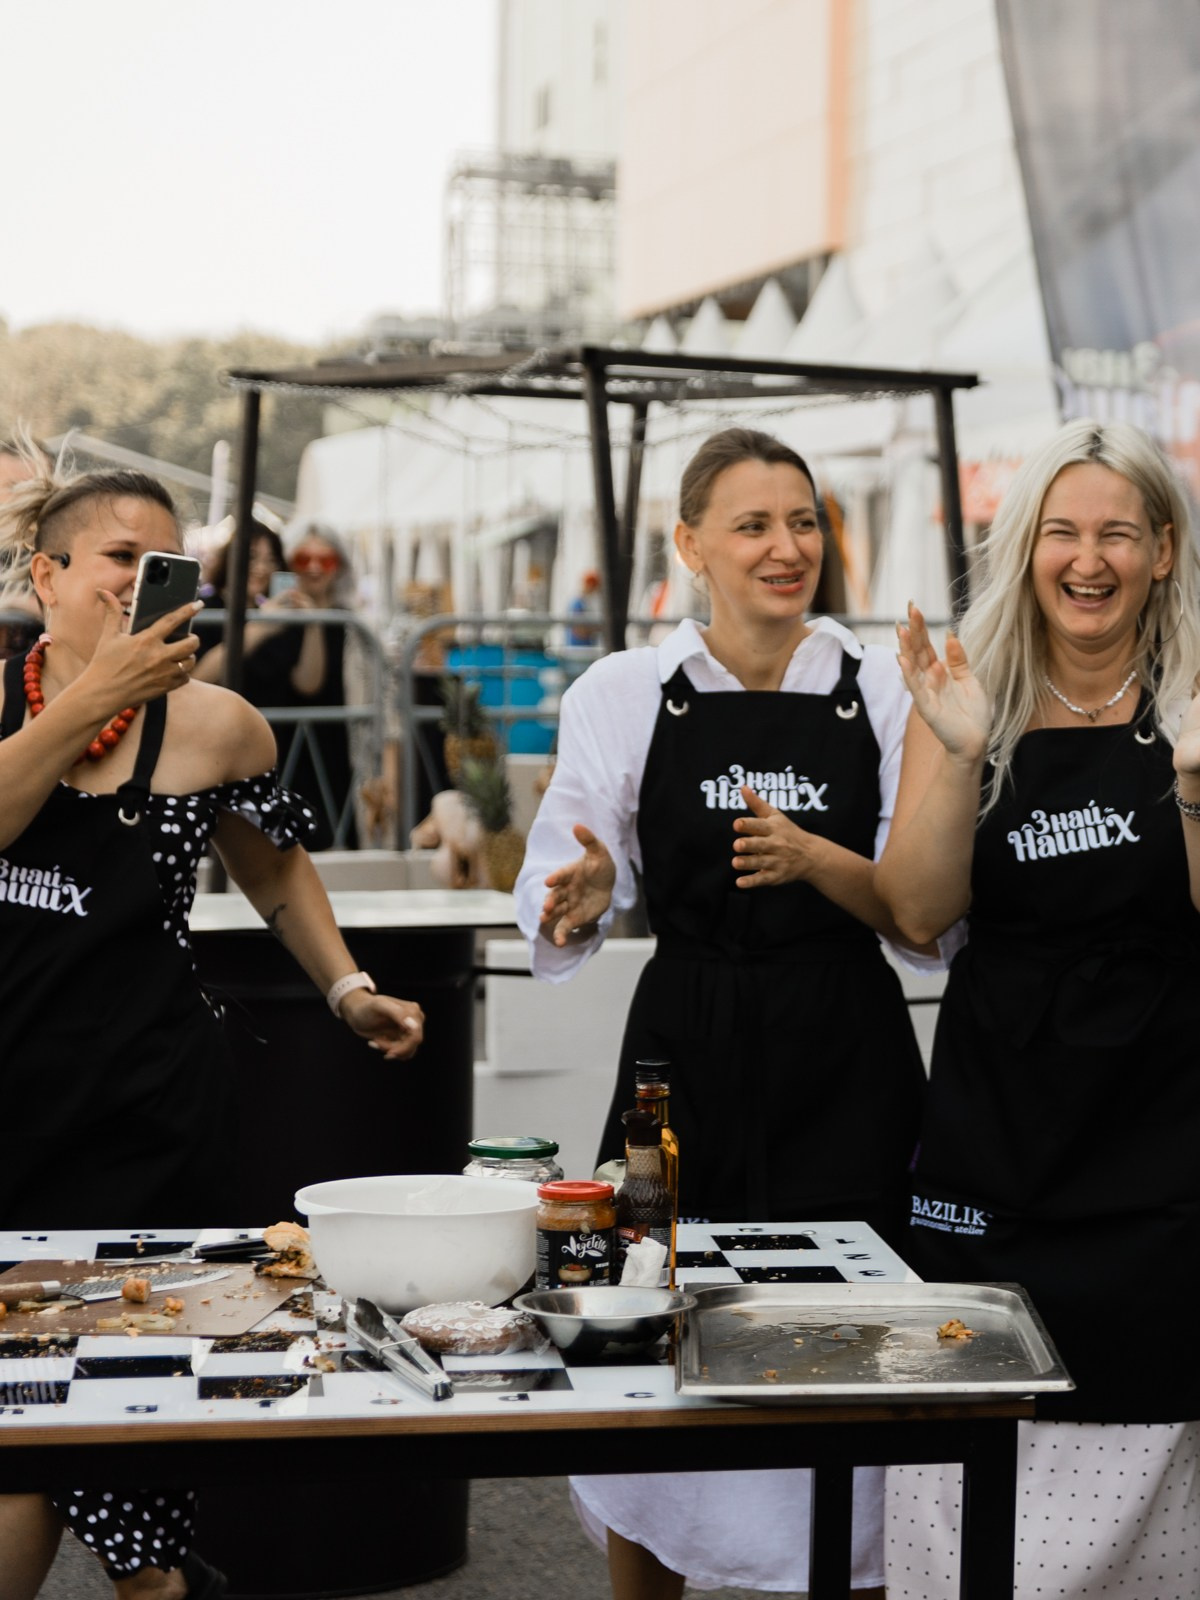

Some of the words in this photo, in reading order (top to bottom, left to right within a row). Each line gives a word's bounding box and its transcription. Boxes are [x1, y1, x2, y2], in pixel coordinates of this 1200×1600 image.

[718, 764, 800, 790] Знай
[1022, 799, 1105, 836] Знай
[911, 1195, 988, 1227] BAZILIK
